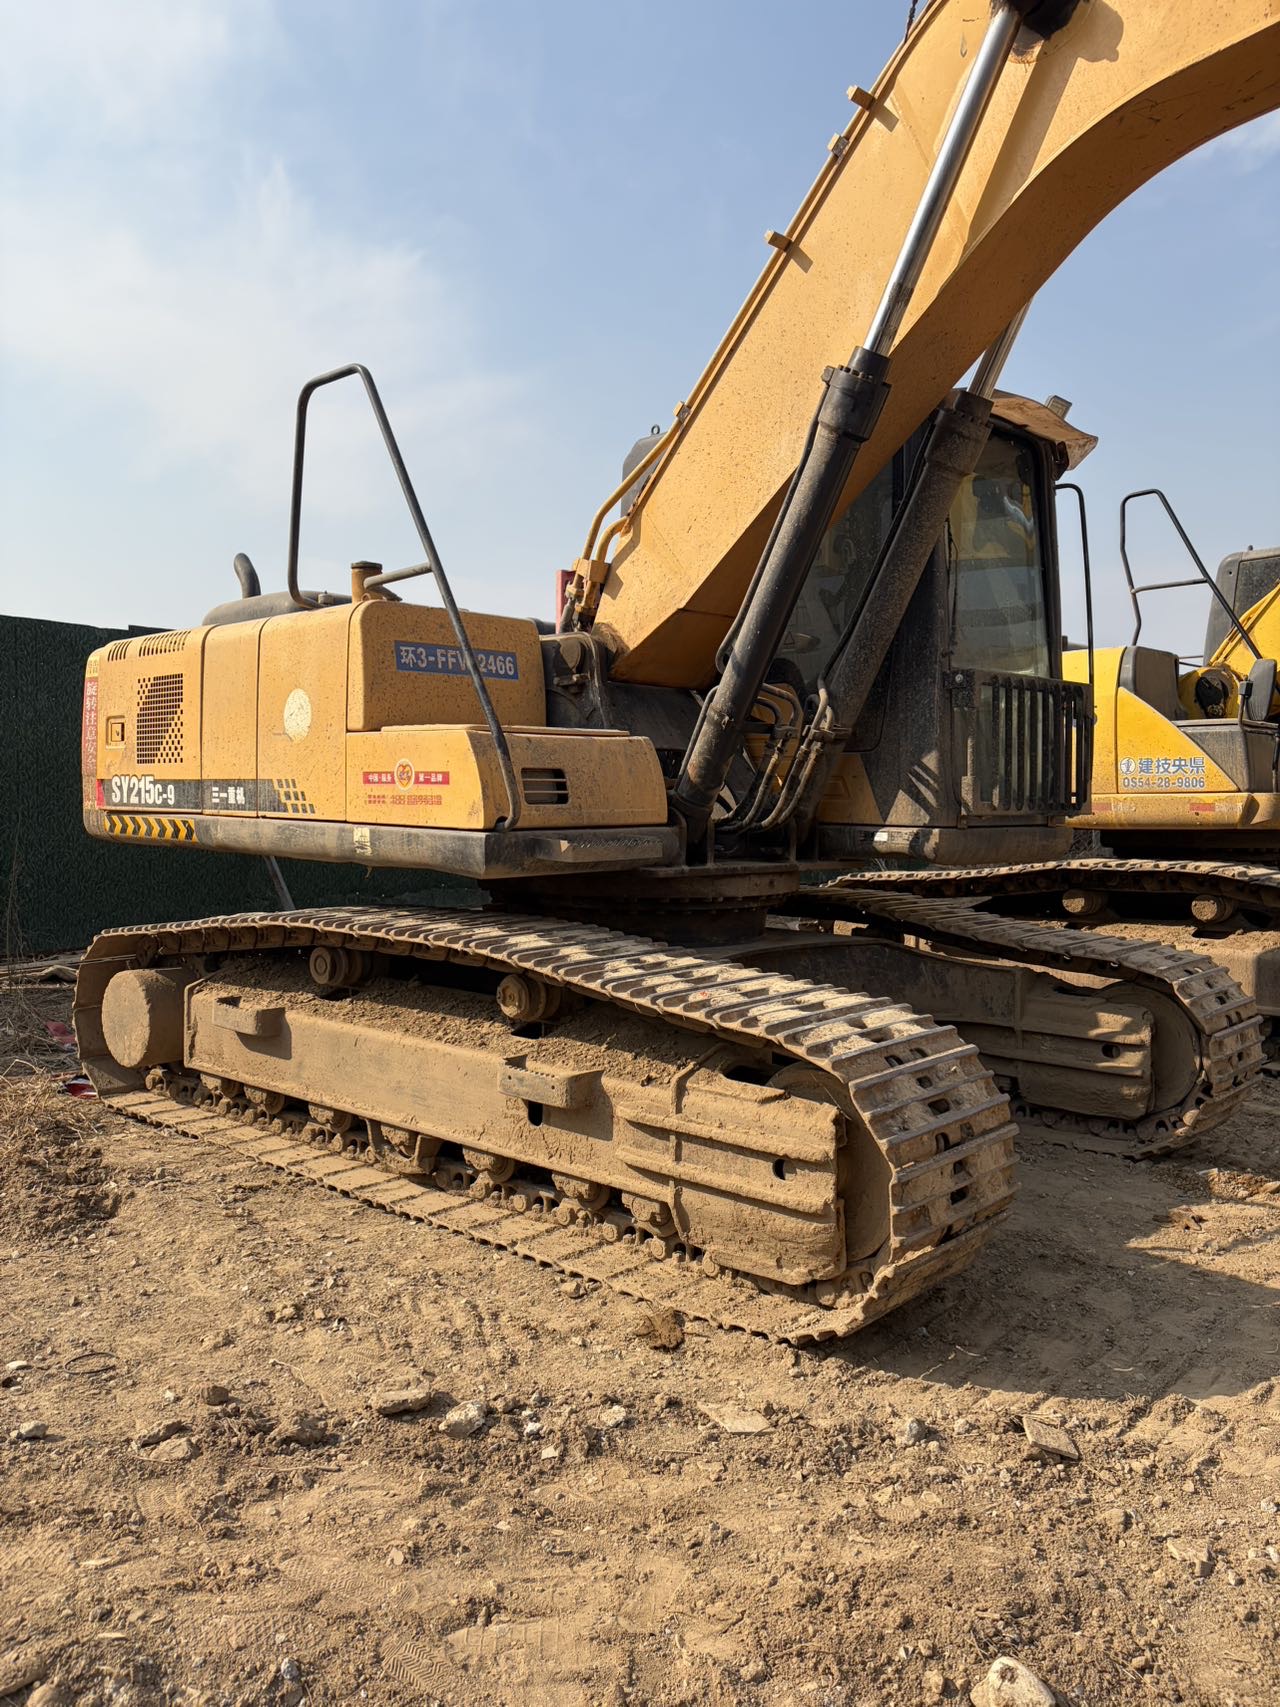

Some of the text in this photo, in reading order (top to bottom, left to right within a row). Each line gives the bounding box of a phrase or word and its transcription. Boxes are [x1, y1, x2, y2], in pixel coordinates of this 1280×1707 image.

[1138, 756, 1206, 775] 建技央県
[111, 775, 175, 805] SY215C-9
